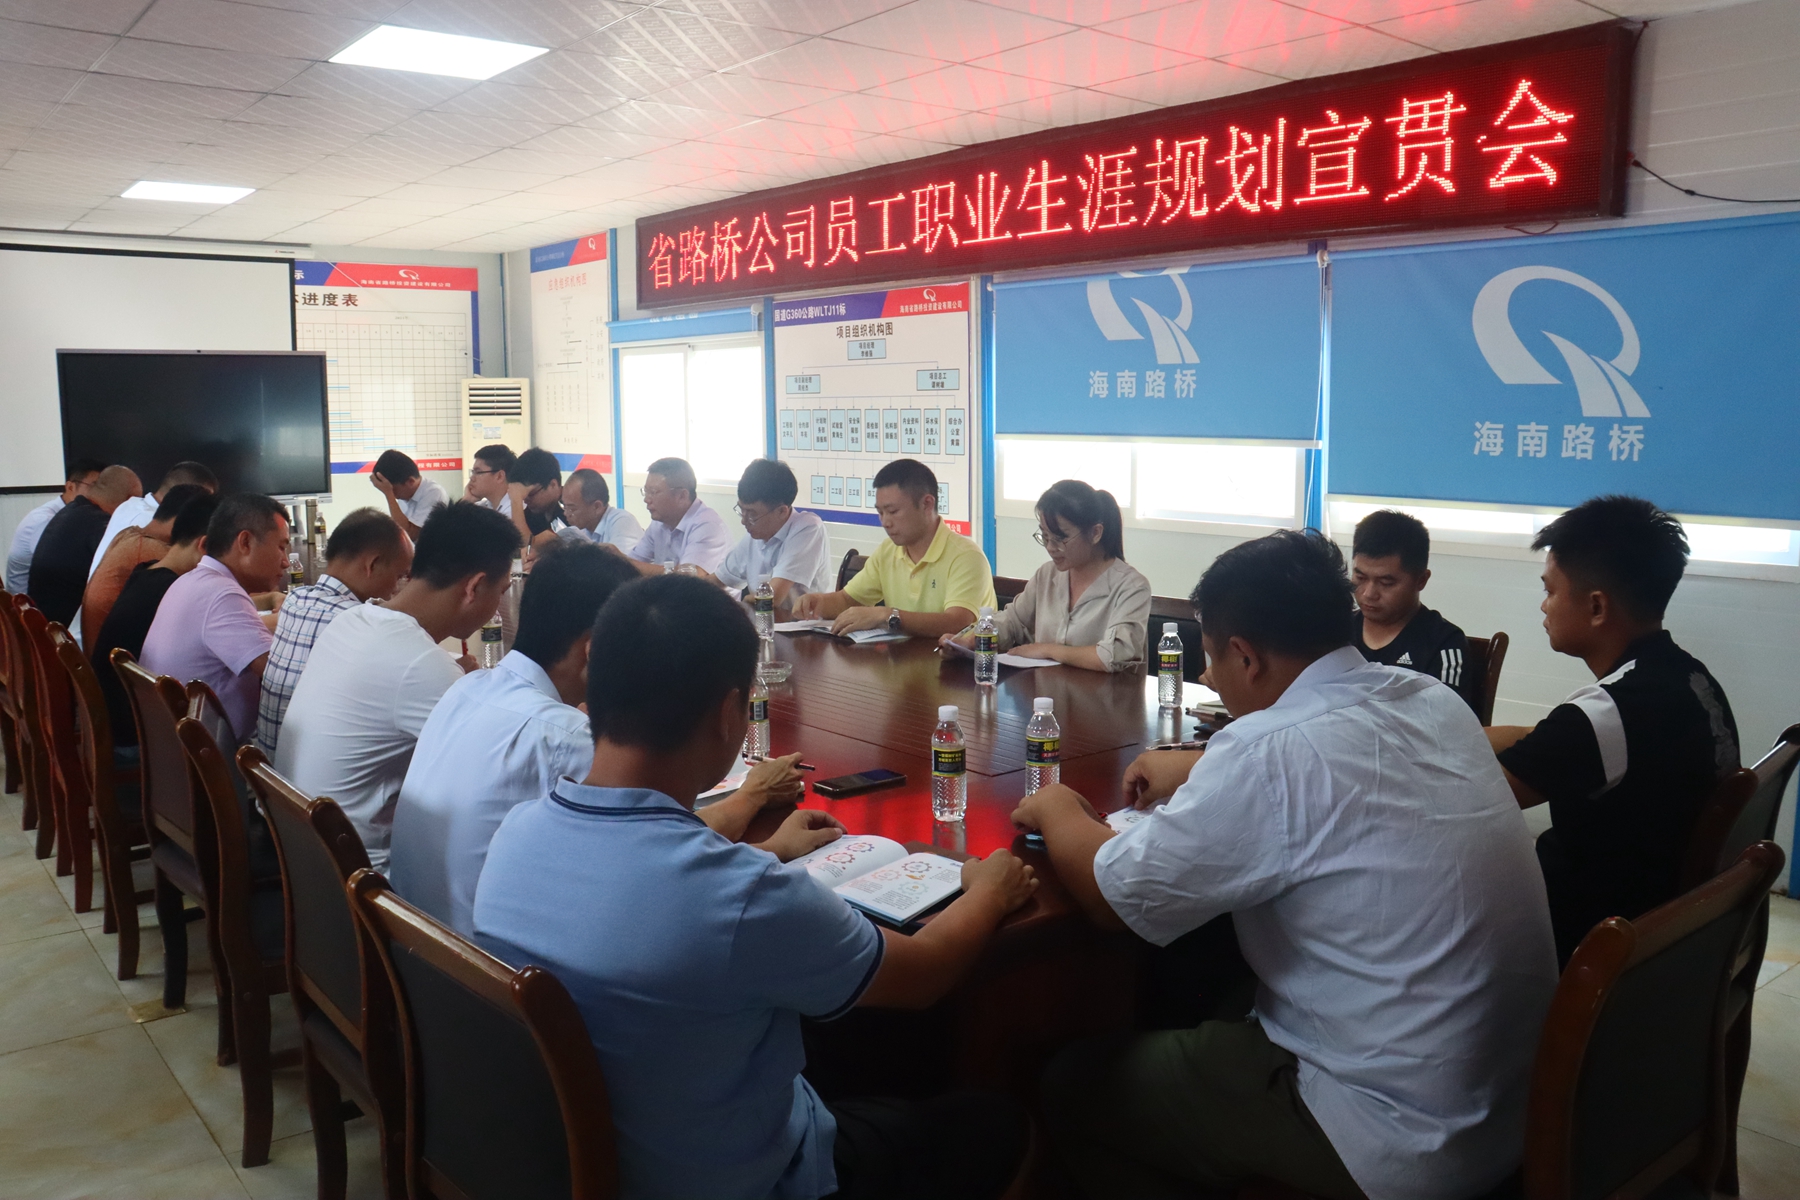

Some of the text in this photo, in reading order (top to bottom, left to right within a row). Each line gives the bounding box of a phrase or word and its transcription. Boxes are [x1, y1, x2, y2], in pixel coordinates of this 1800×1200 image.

[648, 79, 1575, 289] 省路桥公司员工职业生涯规划宣贯会
[774, 303, 846, 322] 国道G360公路WLTJ11标
[899, 300, 963, 314] 海南省路桥投资建设有限公司
[836, 322, 894, 339] 项目组织机构图
[1088, 369, 1197, 399] 海南路桥
[1473, 422, 1646, 462] 海南路桥
